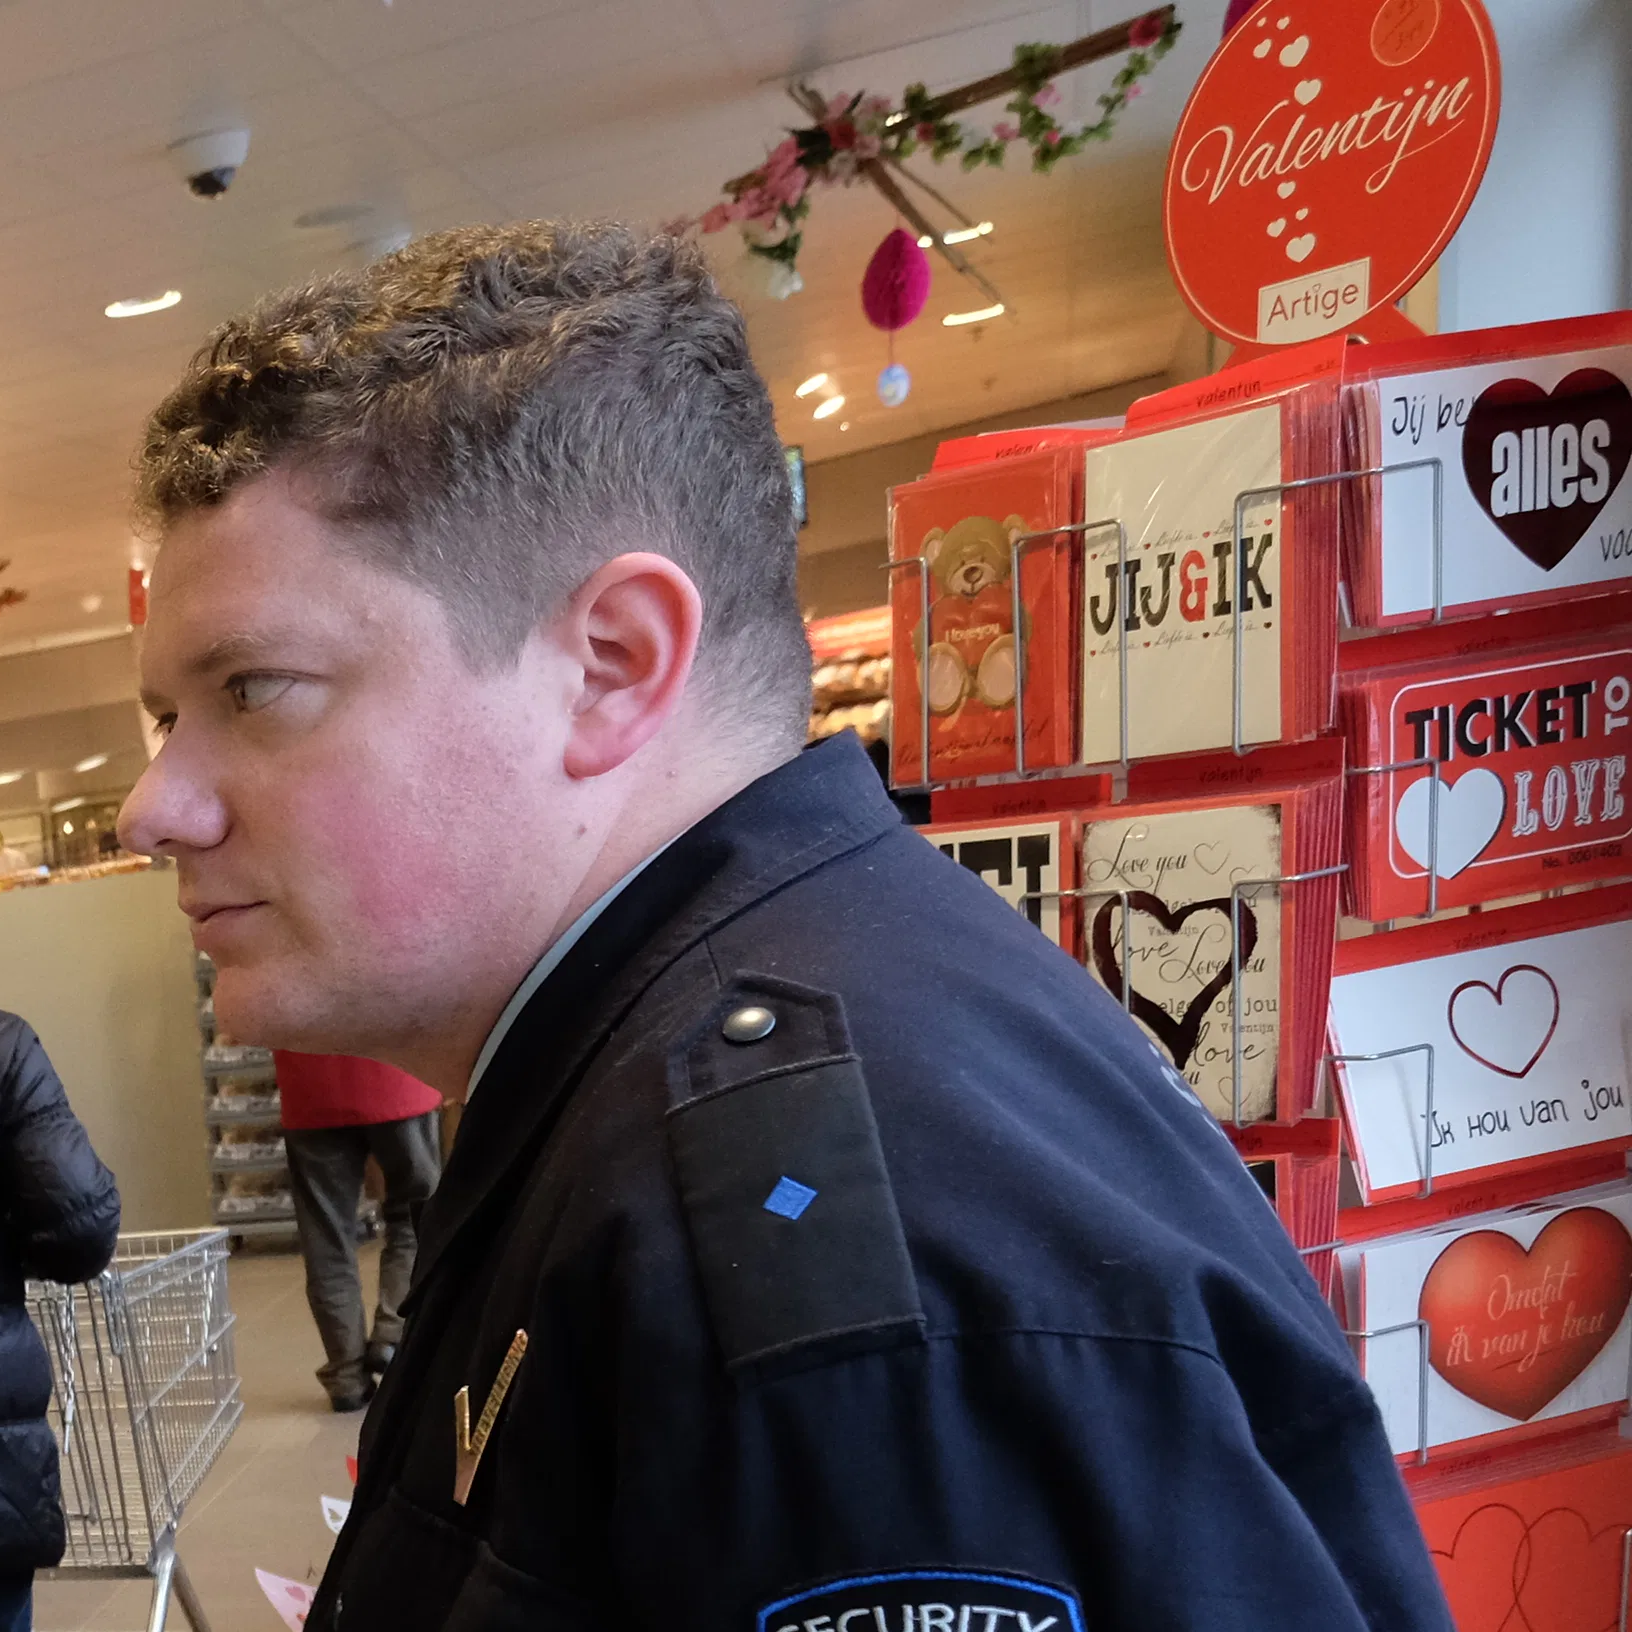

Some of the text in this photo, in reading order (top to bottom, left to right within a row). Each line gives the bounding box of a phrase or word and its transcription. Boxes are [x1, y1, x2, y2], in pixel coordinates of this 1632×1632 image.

[1181, 76, 1473, 205] Valentijn
[1266, 284, 1360, 327] Artige
[1392, 393, 1478, 446] Jij be
[1490, 418, 1612, 518] alles
[1404, 680, 1598, 762] TICKET
[1603, 675, 1632, 736] TO
[1511, 755, 1627, 838] LOVE
[1519, 1098, 1570, 1126] van
[1581, 1079, 1624, 1121] jou
[1487, 1260, 1577, 1321] Omdat
